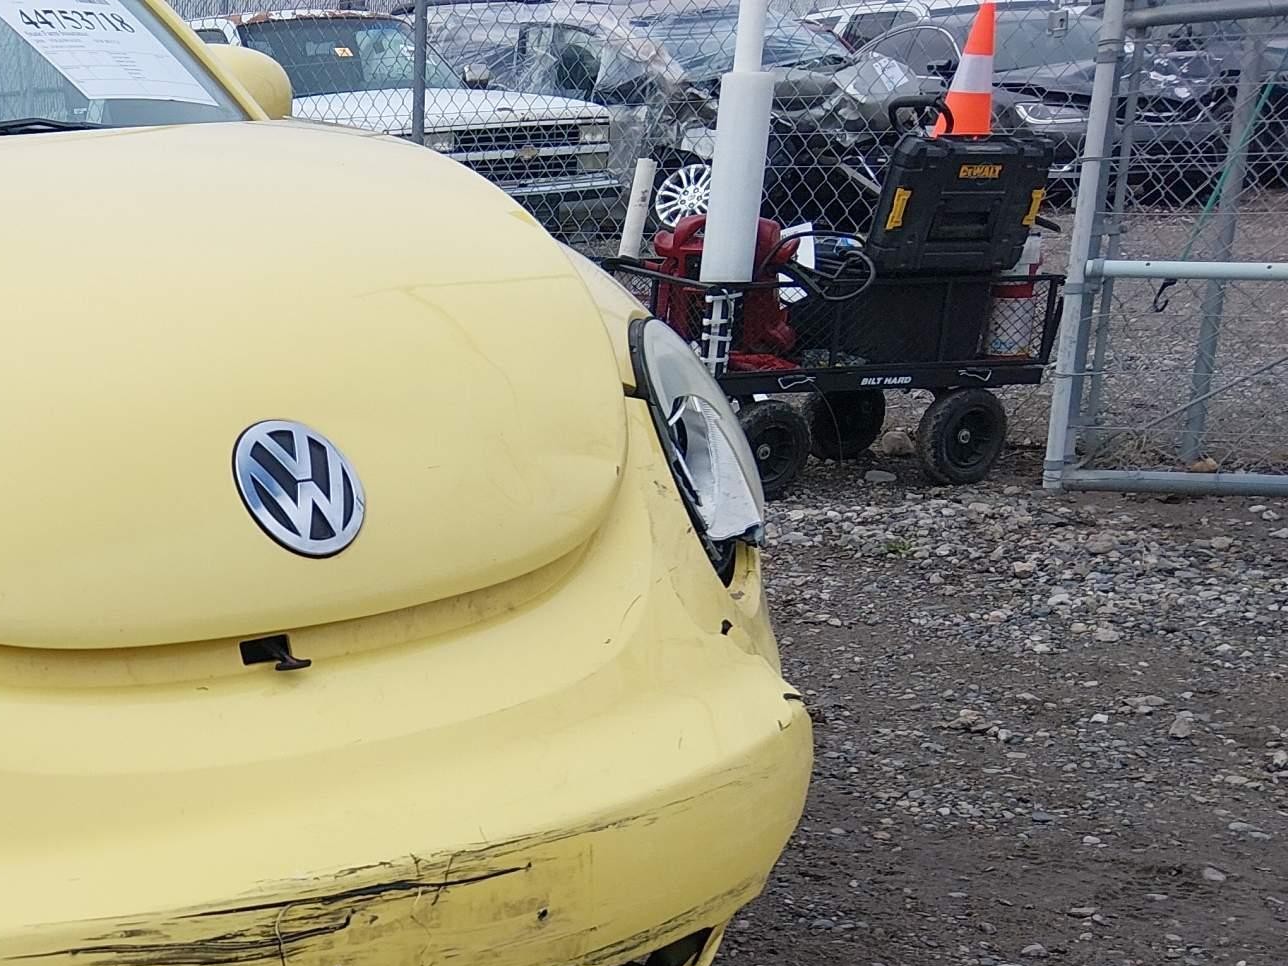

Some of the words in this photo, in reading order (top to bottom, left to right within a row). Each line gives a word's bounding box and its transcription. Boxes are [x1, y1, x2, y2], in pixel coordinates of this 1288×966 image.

[19, 9, 135, 33] 44753718
[860, 377, 883, 386] BILT
[883, 376, 912, 385] HARD
[234, 420, 365, 556] VW
